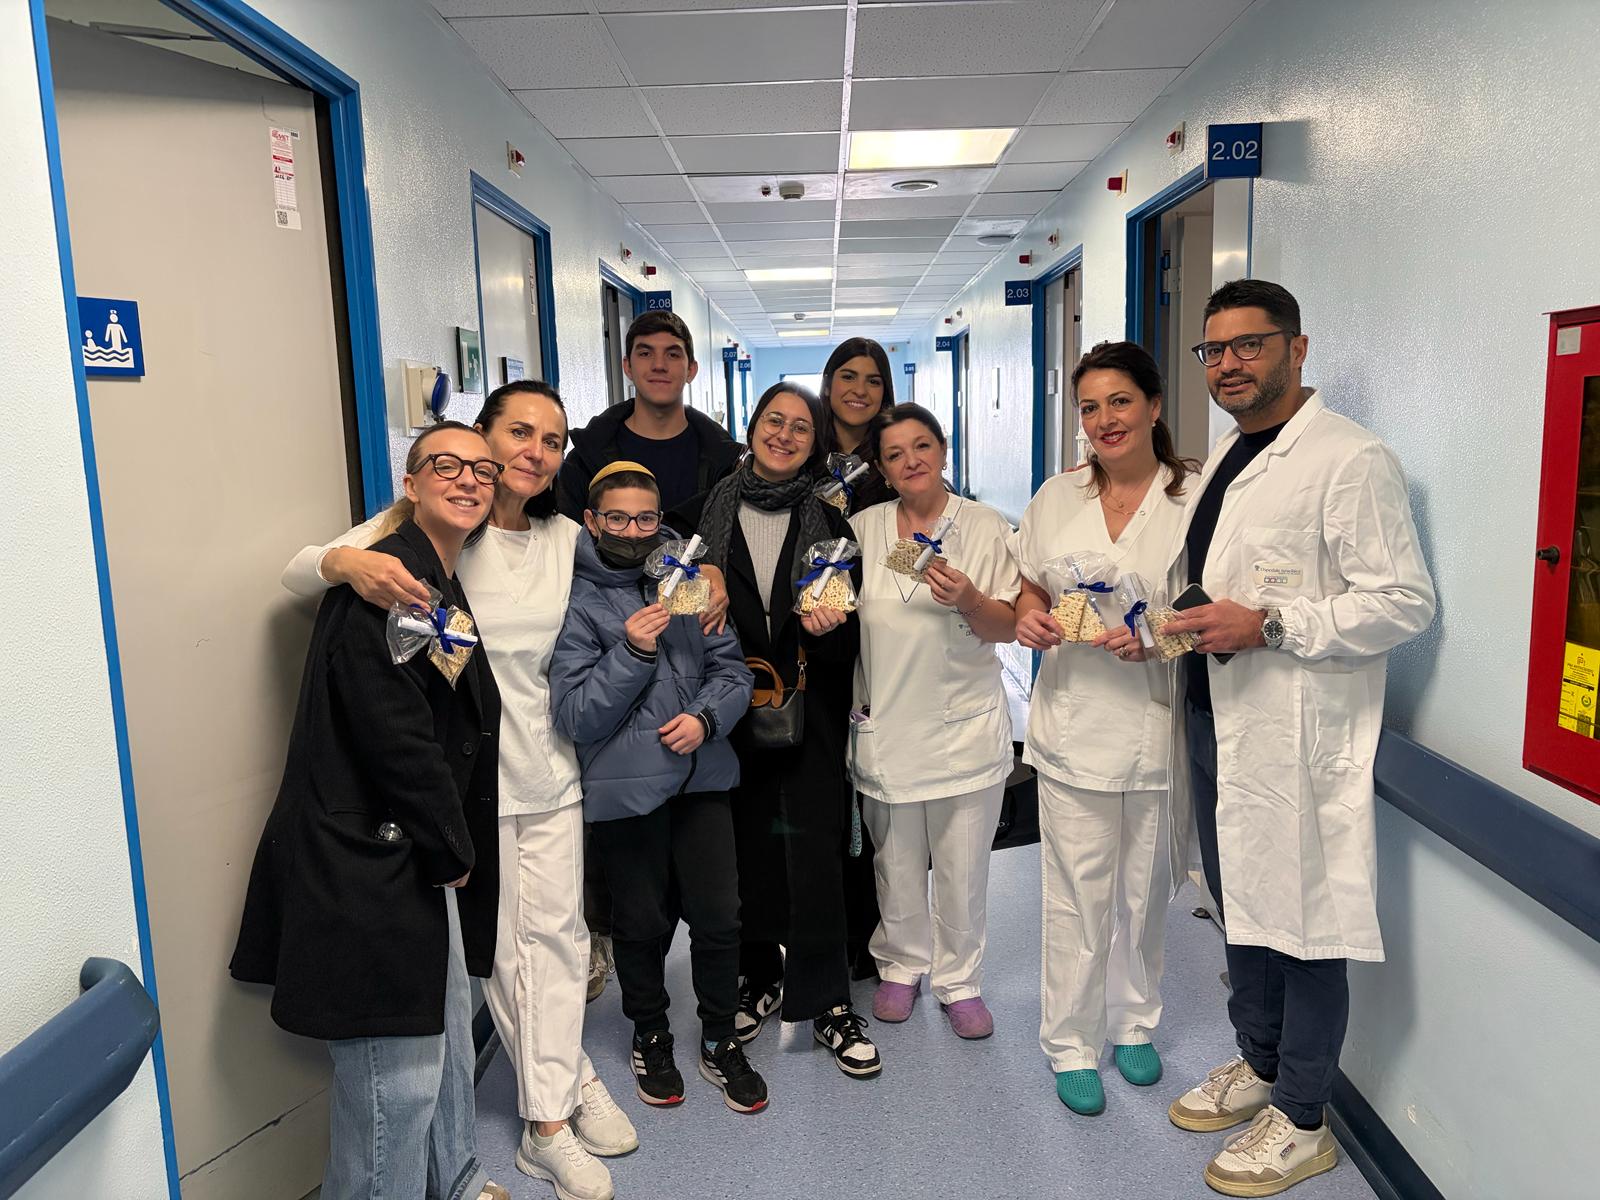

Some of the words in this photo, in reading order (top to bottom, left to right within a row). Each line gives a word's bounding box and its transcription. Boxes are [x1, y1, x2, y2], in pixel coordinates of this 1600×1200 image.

[1212, 140, 1258, 160] 2.02
[1007, 288, 1029, 299] 2.03
[649, 298, 671, 309] 2.08
